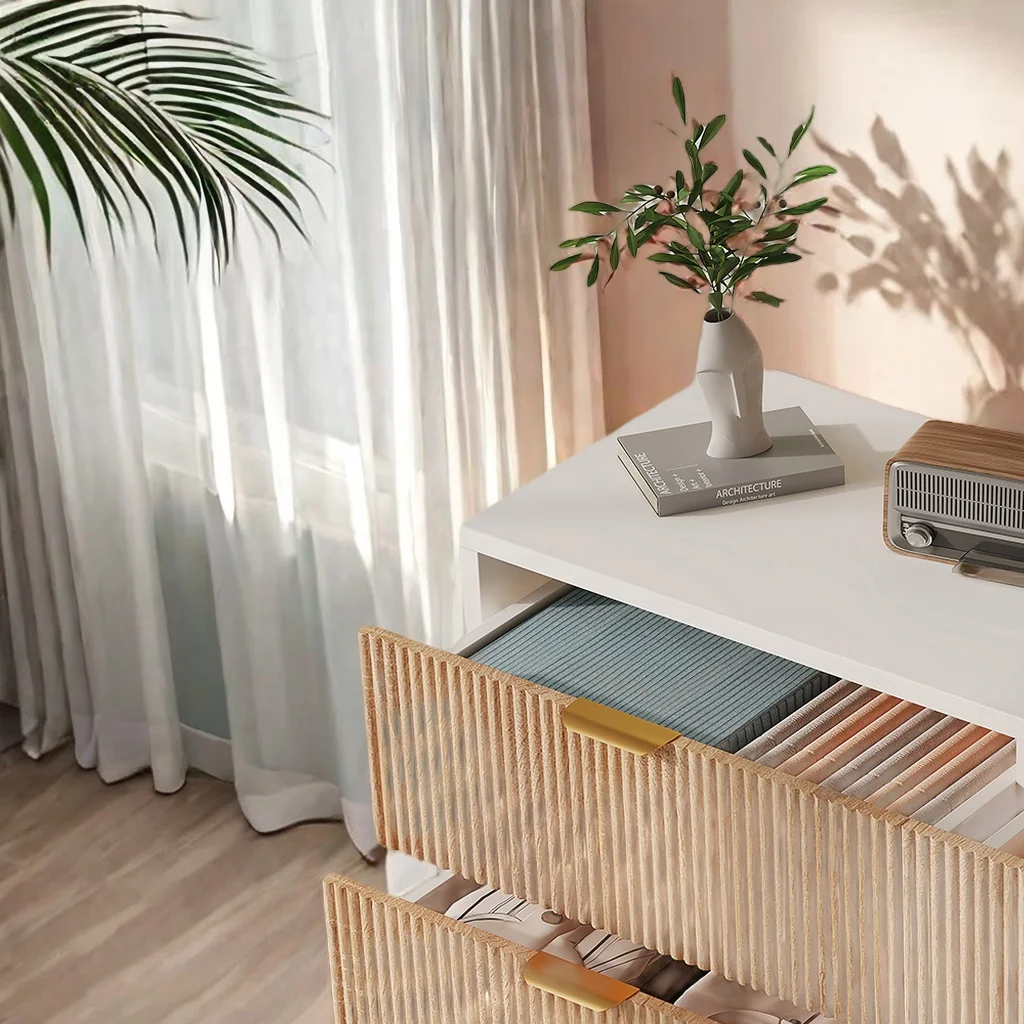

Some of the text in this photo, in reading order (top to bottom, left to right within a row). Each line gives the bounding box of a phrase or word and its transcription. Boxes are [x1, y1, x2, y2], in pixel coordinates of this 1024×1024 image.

[715, 479, 782, 499] ARCHITECTURE
[721, 498, 740, 506] Design
[740, 493, 768, 503] Architecture
